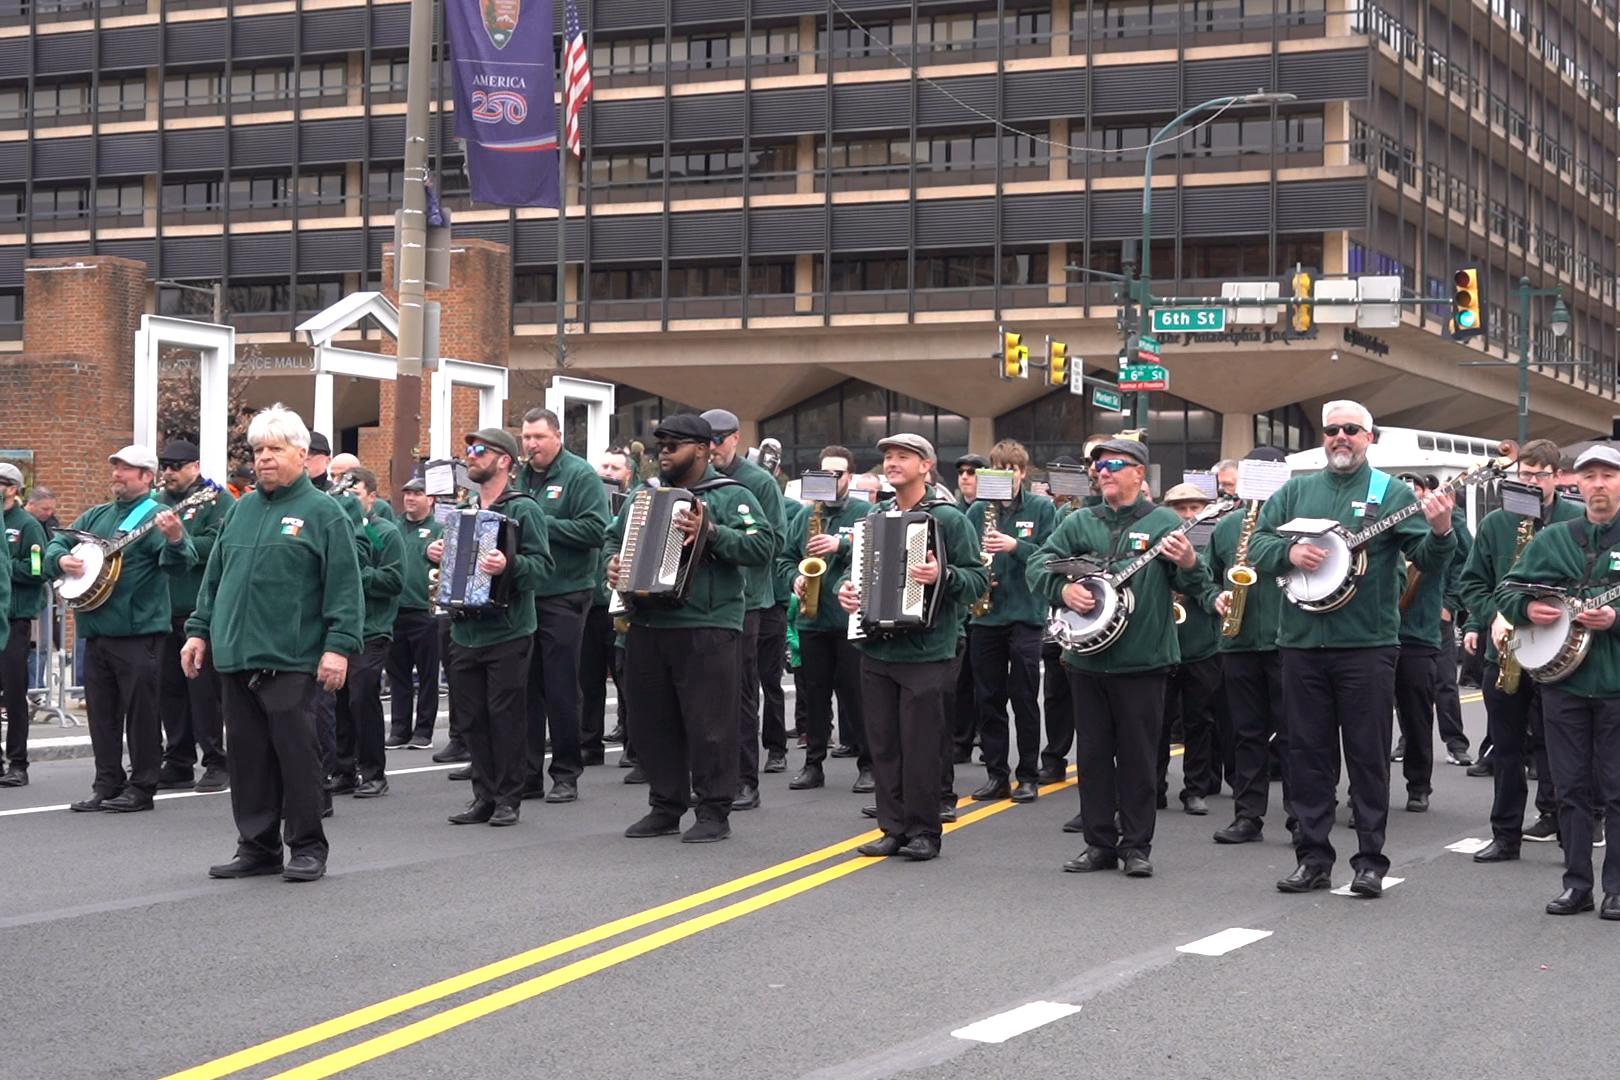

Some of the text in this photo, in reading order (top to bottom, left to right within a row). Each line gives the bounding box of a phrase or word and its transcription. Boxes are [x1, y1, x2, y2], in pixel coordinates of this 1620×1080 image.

[472, 74, 526, 89] AMERICA
[472, 90, 528, 125] 250
[1161, 312, 1216, 326] 6th St
[274, 356, 307, 369] MALL
[1151, 370, 1163, 380] St
